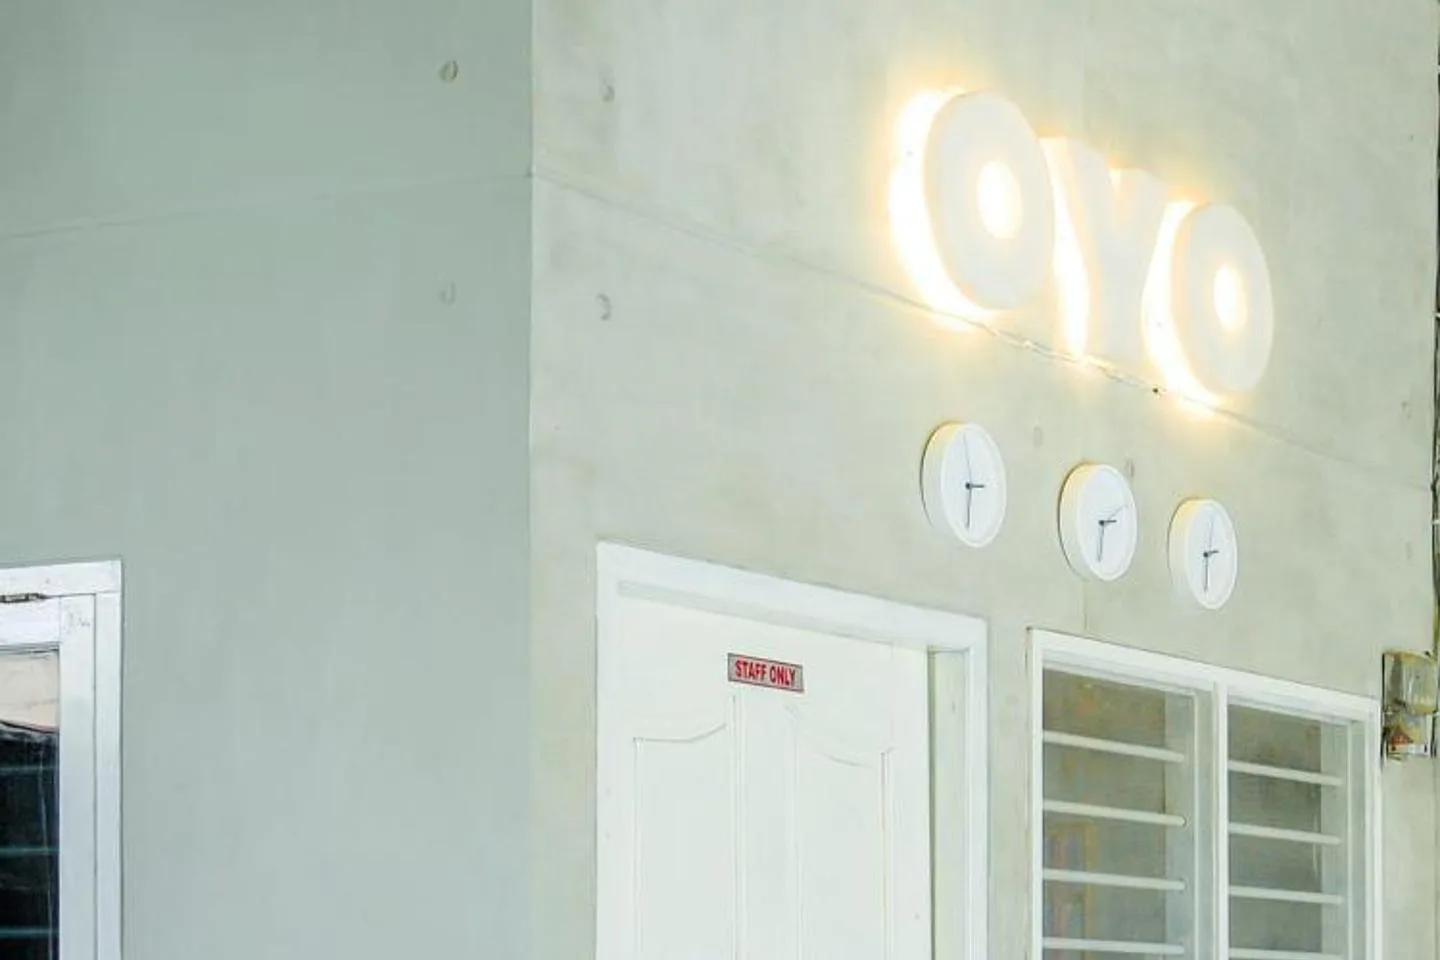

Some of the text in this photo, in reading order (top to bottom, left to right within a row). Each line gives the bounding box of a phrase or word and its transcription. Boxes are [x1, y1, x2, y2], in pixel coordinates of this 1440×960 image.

[923, 89, 1275, 396] OYO
[735, 660, 795, 686] STAFF ONLY
